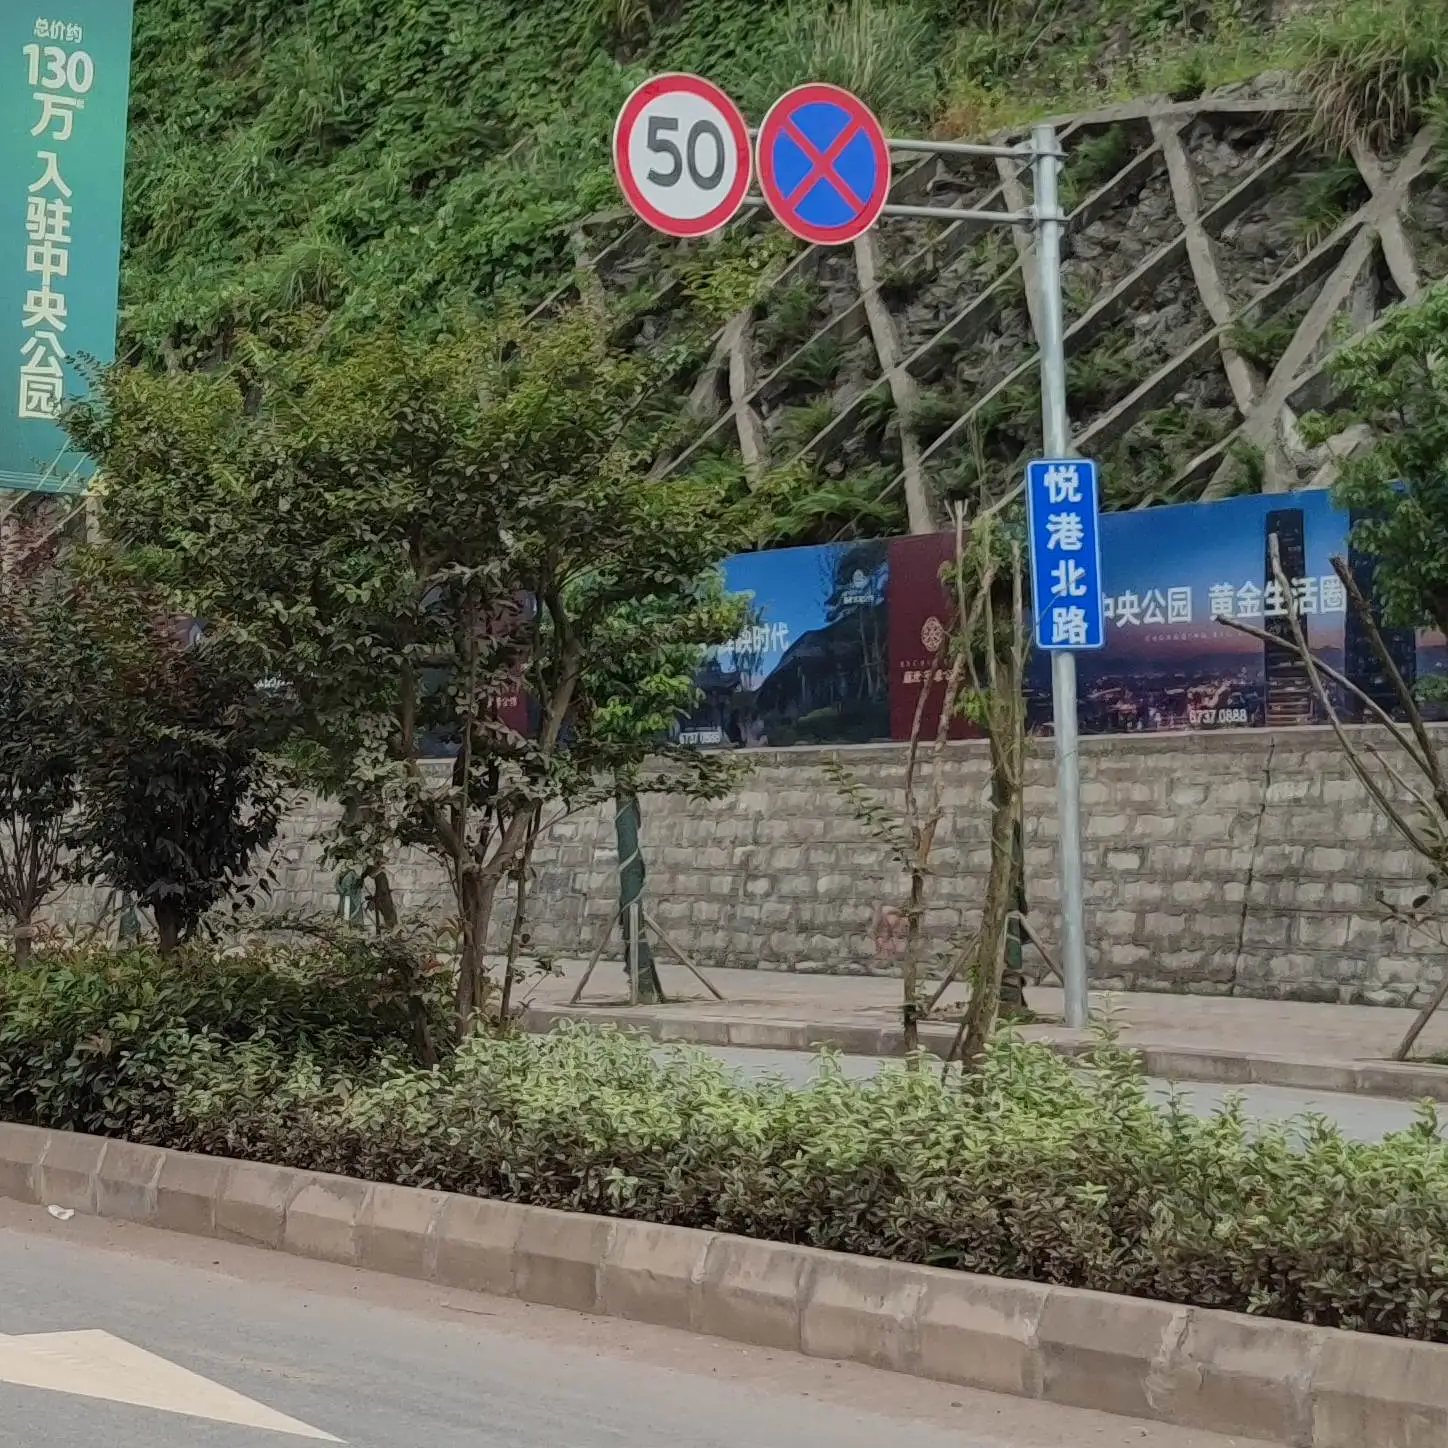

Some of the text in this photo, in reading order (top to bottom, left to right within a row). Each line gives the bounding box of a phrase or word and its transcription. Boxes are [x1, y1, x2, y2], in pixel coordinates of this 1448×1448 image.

[33, 17, 84, 44] 总价约
[22, 44, 95, 94] 130
[645, 116, 726, 191] 50
[1043, 464, 1089, 645] 悦港北路
